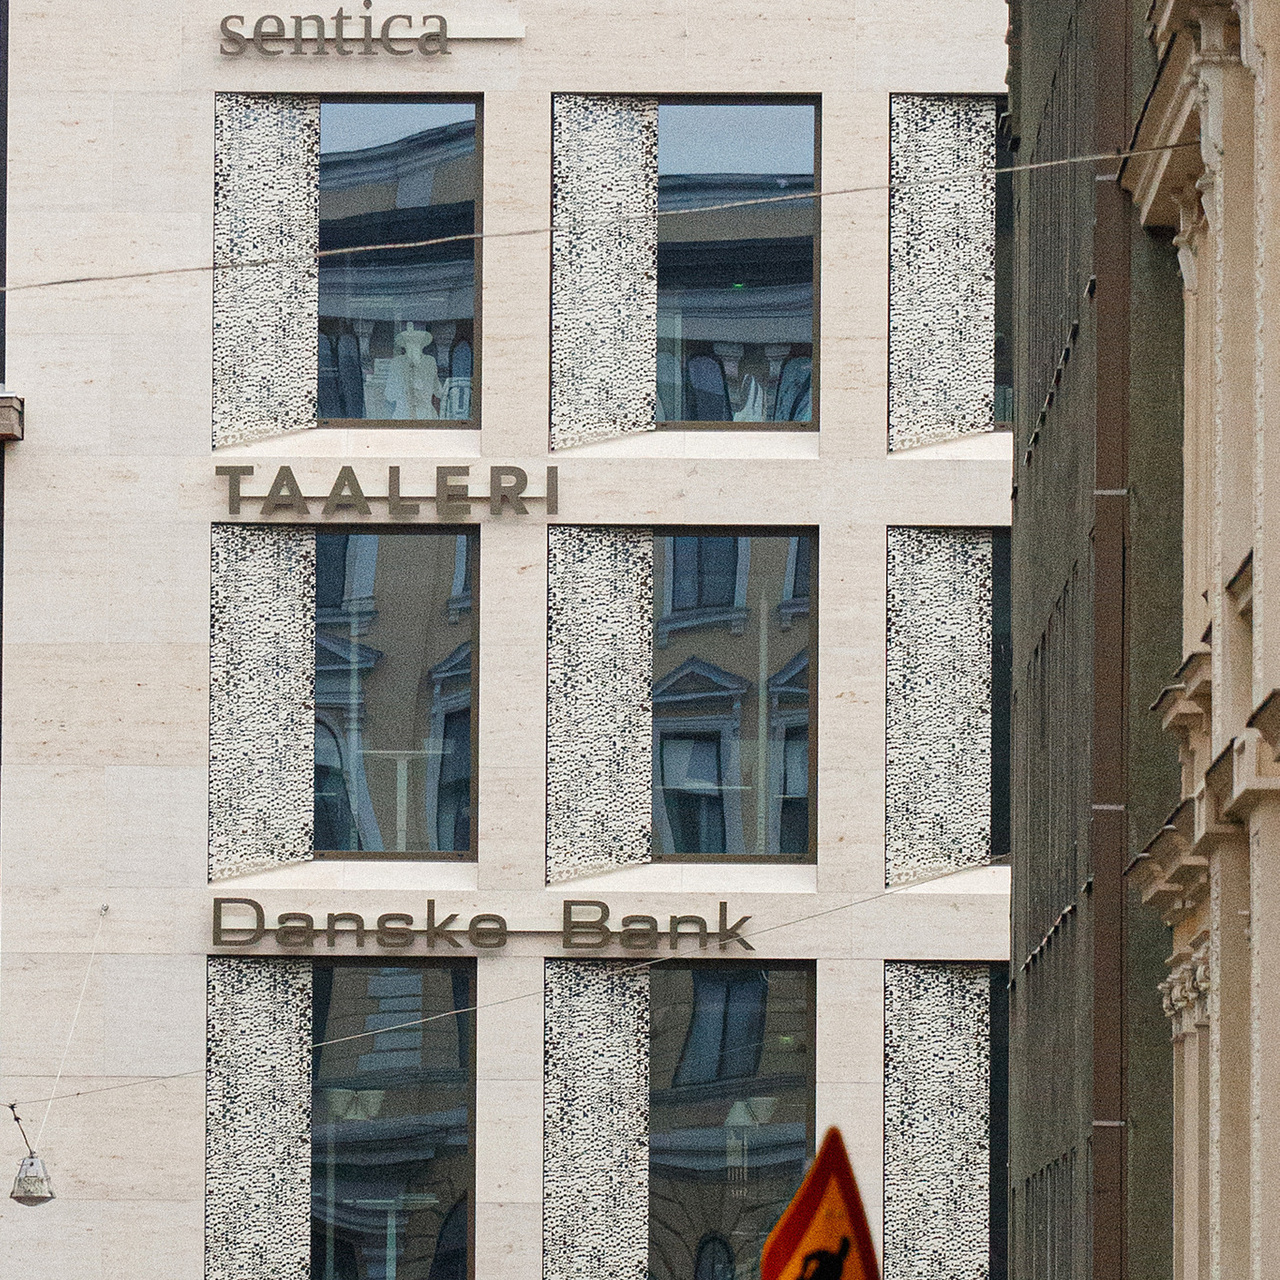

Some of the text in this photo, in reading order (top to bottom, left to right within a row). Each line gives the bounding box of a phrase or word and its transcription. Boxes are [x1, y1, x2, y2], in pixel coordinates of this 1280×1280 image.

[215, 465, 559, 516] TAALERI
[212, 897, 756, 951] Danske Bank
